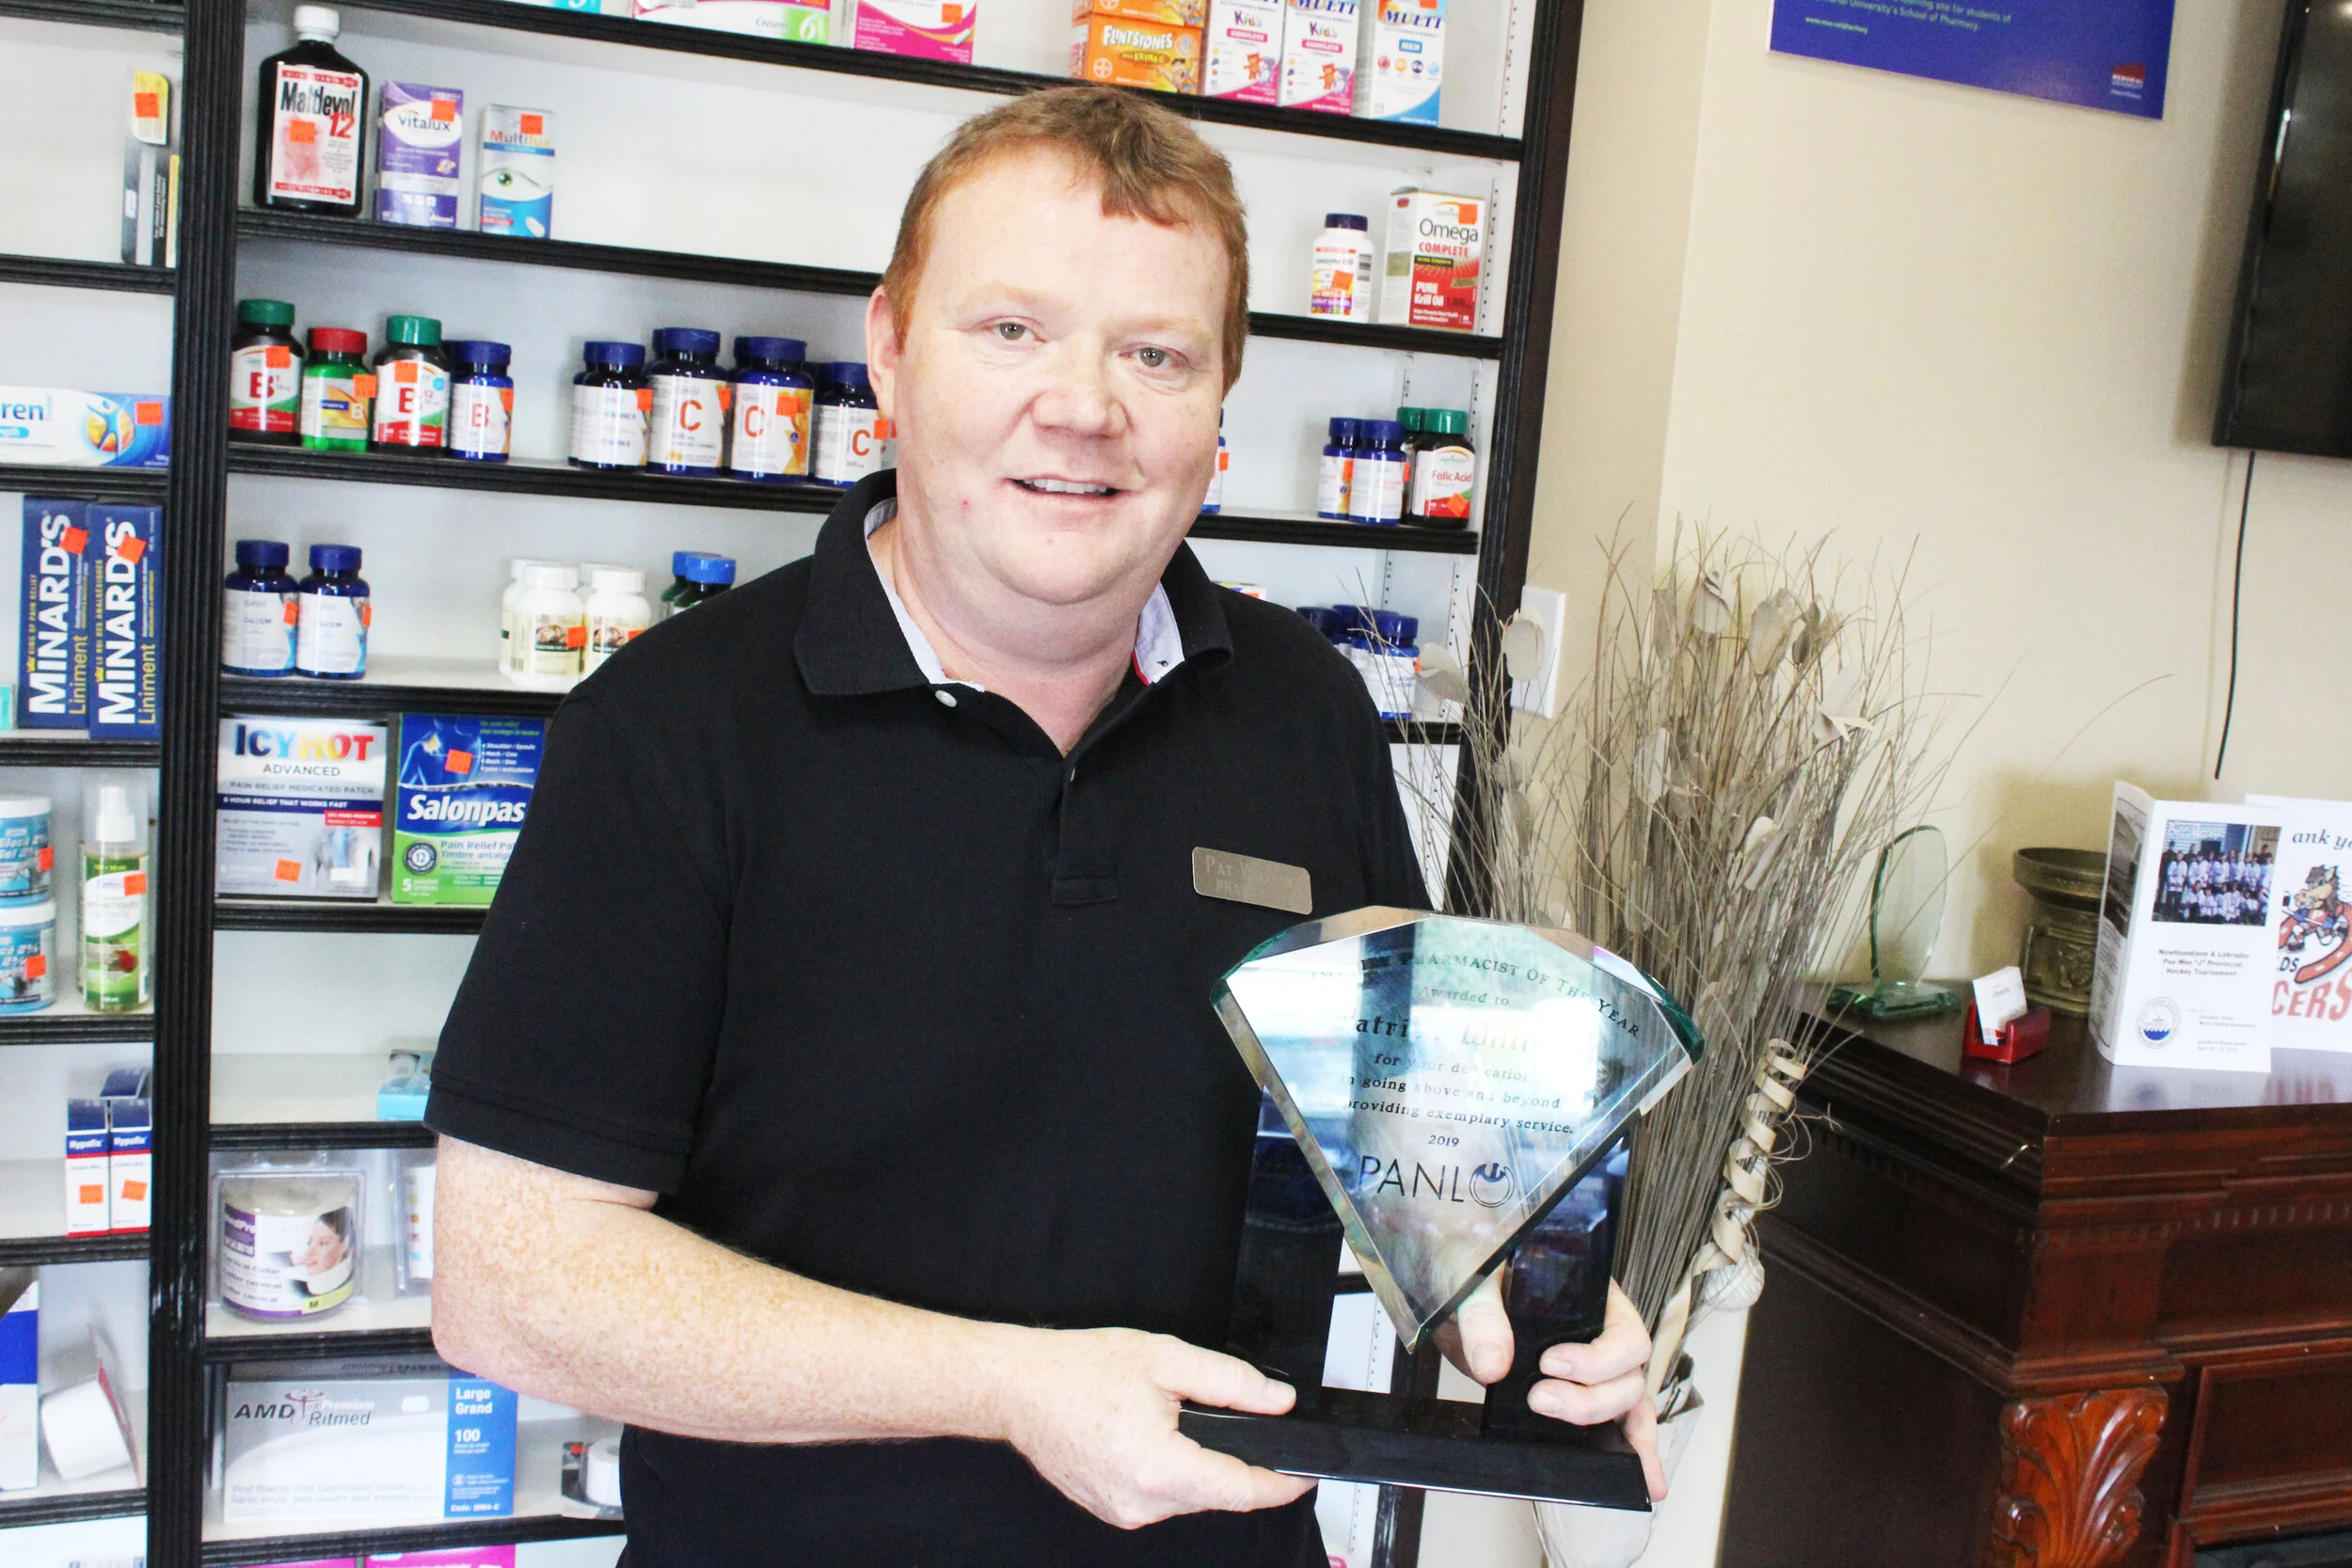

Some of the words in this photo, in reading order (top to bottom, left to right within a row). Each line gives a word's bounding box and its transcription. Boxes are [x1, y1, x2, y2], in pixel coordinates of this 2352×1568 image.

[755, 16, 788, 30] Cream
[1233, 9, 1263, 27] Kids
[1383, 9, 1442, 29] MULTI
[1103, 24, 1173, 50] FLINTSTONES
[1310, 21, 1338, 39] Kids
[328, 111, 357, 140] 12
[1419, 217, 1479, 245] Omega
[1418, 241, 1470, 258] COMPLETE
[1415, 280, 1438, 293] PURE
[471, 403, 490, 428] B
[679, 399, 703, 432] C
[744, 404, 766, 438] C
[851, 429, 871, 457] C
[1431, 469, 1453, 483] Folic
[1454, 471, 1472, 483] Acid
[28, 514, 72, 715] MINARD'S
[97, 520, 136, 724] MINARD'S
[69, 635, 88, 715] Liniment
[138, 643, 157, 725] Liniment
[262, 763, 342, 777] ADVANCED
[230, 781, 253, 789] PAIN
[254, 783, 284, 791] RELIEF
[288, 784, 342, 794] MEDICATED
[342, 786, 375, 796] PATCH
[252, 798, 278, 806] RELIEF
[406, 793, 527, 827] Salonpas
[440, 840, 464, 848] Pain
[467, 840, 497, 849] Relief
[2292, 828, 2331, 844] ank
[440, 849, 475, 859] Timbre
[402, 878, 413, 893] 5
[2158, 948, 2209, 958] Newfoundland
[2166, 967, 2192, 976] Hockey
[2194, 968, 2237, 976] Tournament
[1418, 986, 1488, 1004] Awarded
[1494, 995, 1510, 1006] to
[1597, 998, 1640, 1037] YEAR
[1373, 1053, 1400, 1067] for
[1361, 1076, 1407, 1092] going
[1413, 1084, 1461, 1098] above
[1502, 1093, 1561, 1110] beyond
[1425, 1108, 1512, 1129] exemplary
[1515, 1118, 1575, 1135] service.
[1427, 1133, 1460, 1148] 2019
[309, 1300, 320, 1309] M
[454, 1386, 492, 1402] Large
[234, 1402, 295, 1419] AMD
[321, 1398, 374, 1411] Premium
[454, 1402, 494, 1416] Grand
[309, 1410, 373, 1427] Ritmed
[454, 1428, 482, 1443] 100
